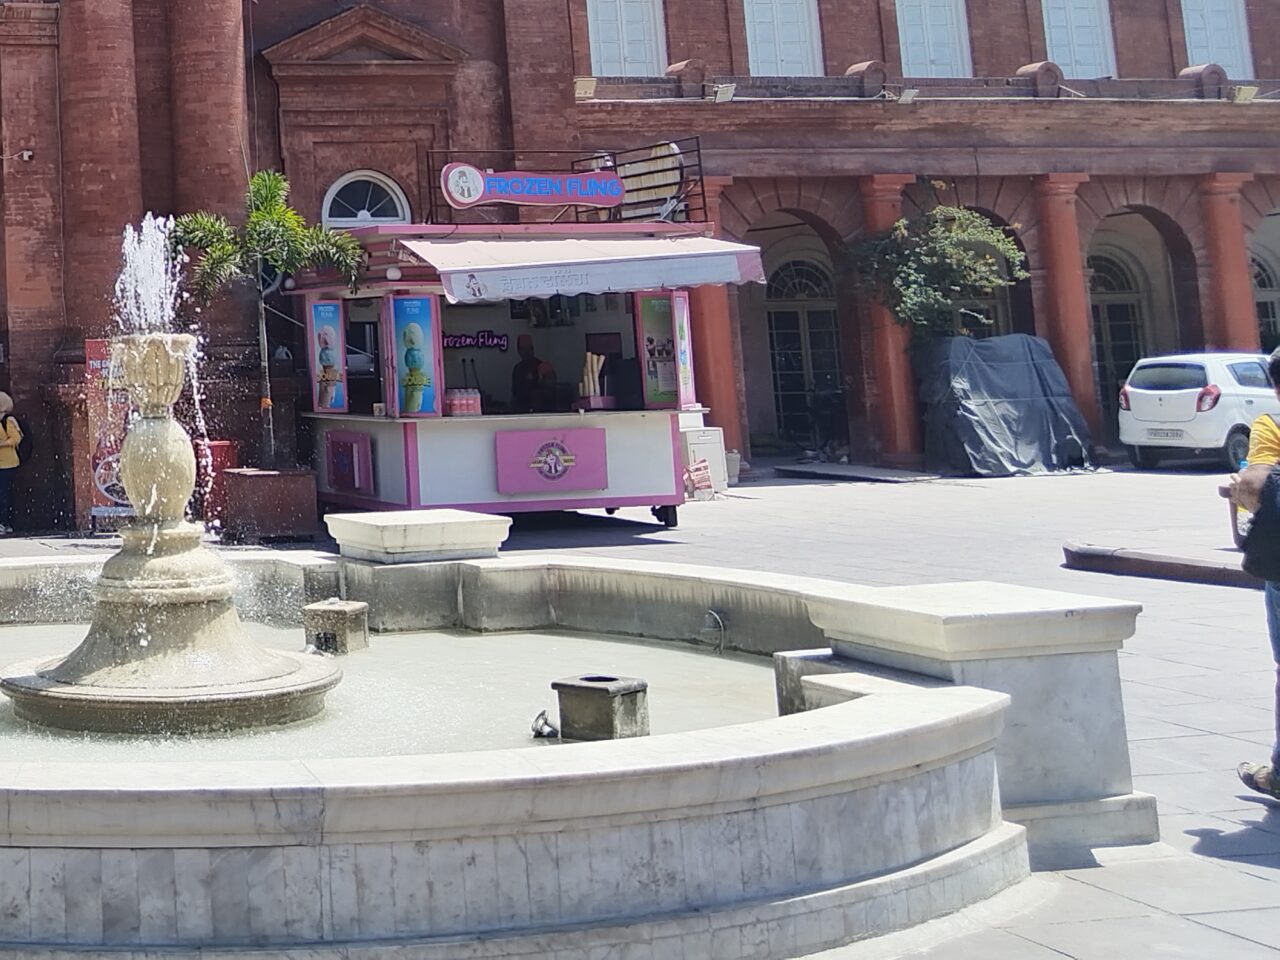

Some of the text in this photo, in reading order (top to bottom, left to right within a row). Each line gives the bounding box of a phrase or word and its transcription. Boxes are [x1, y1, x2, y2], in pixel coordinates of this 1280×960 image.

[484, 176, 623, 198] FROZEN FLING
[440, 331, 476, 347] rozen
